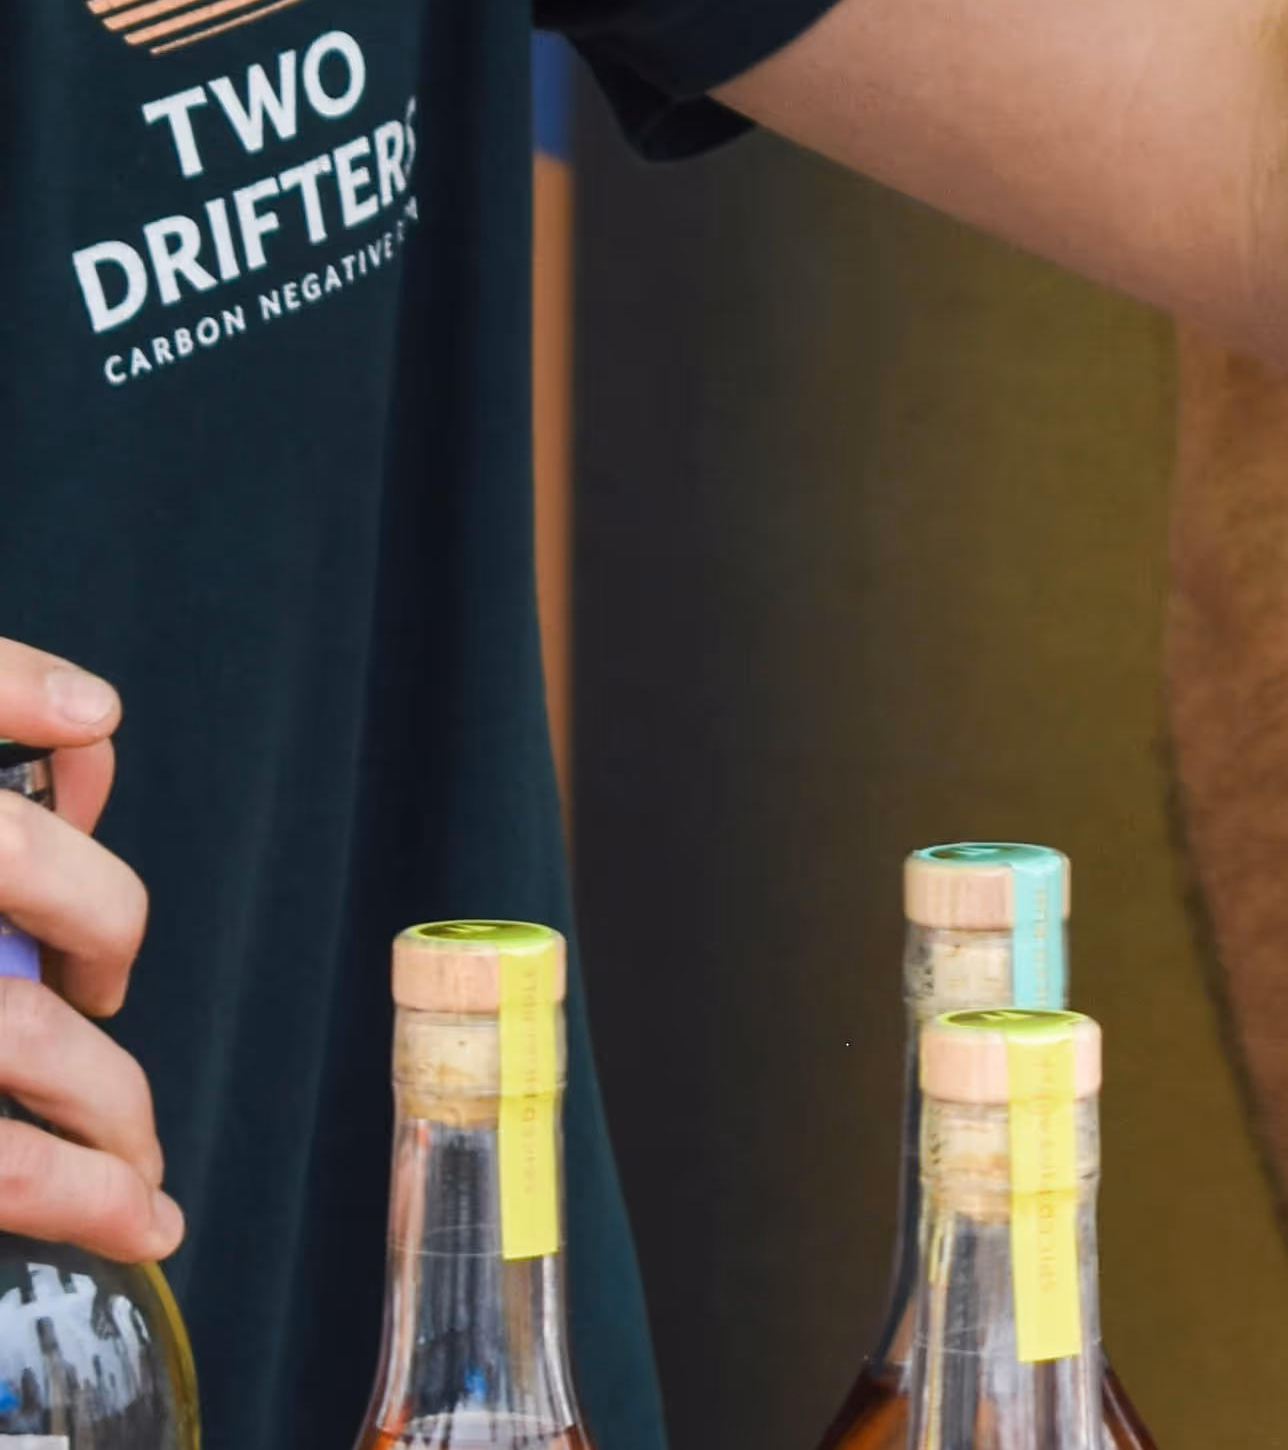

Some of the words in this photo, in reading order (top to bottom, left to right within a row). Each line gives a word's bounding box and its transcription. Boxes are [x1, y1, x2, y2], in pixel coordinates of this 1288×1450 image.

[142, 29, 366, 179] TWO
[72, 94, 417, 334] DRIFTERS
[104, 305, 247, 385] CARBON
[259, 232, 395, 324] NEGATIVE
